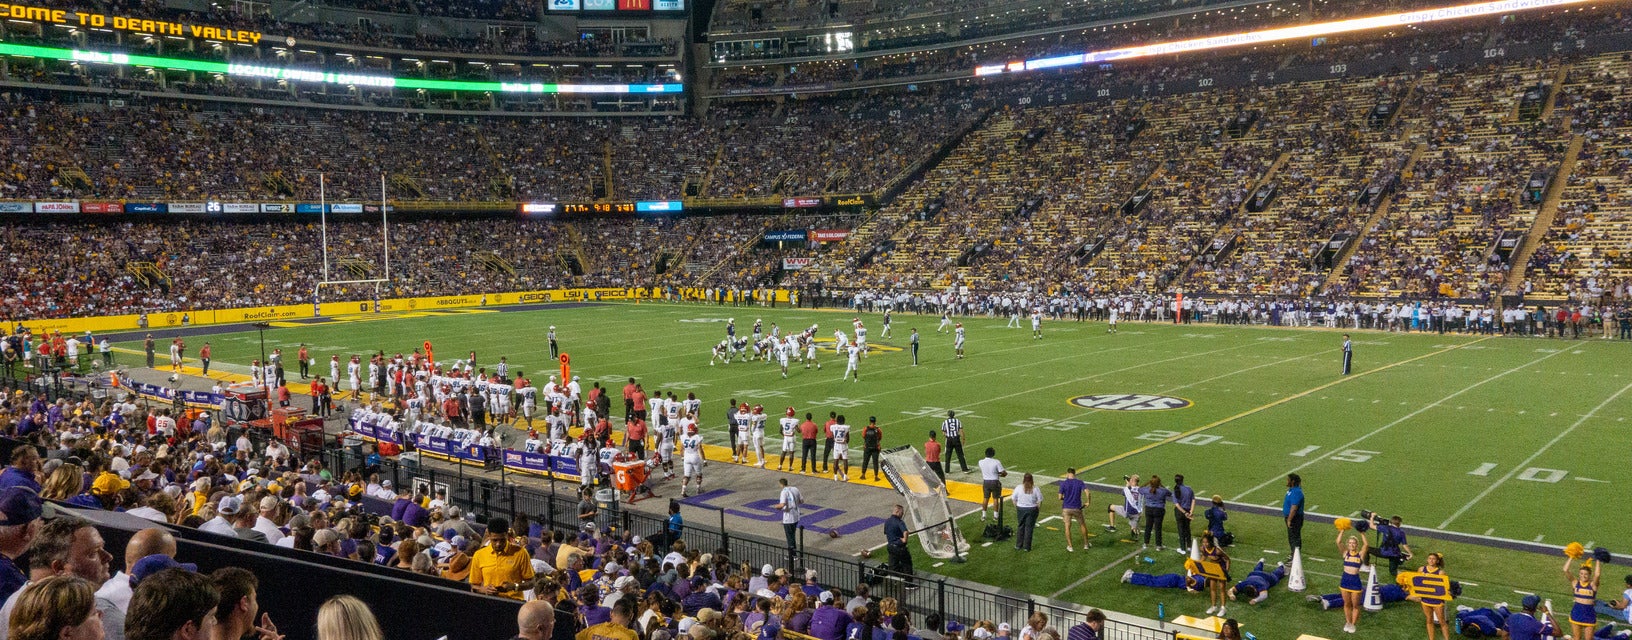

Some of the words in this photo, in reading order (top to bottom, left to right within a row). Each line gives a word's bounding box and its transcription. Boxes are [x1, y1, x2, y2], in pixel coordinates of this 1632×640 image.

[1438, 6, 1485, 17] Chicken
[0, 3, 66, 23] COME
[75, 12, 105, 27] TO
[113, 16, 182, 35] DEATH
[190, 25, 261, 43] VALLEY
[1483, 48, 1505, 58] 104
[1330, 64, 1347, 74] 103
[228, 64, 280, 78] LOCALLY
[282, 68, 324, 82] OWNED
[337, 74, 395, 88] OPERATED
[1198, 78, 1213, 87] 102
[1097, 89, 1110, 97] 101
[1018, 97, 1031, 105] 100
[207, 201, 221, 212] 26
[563, 290, 581, 298] LSU
[410, 402, 420, 410] 84
[157, 420, 168, 428] 25
[784, 423, 791, 431] 5
[948, 421, 955, 431] S
[683, 439, 696, 448] 54
[1290, 445, 1382, 463] 15
[617, 470, 626, 484] G
[1467, 462, 1570, 483] 10
[672, 488, 889, 536] LSU
[1370, 574, 1381, 606] LSU
[1412, 575, 1446, 597] S
